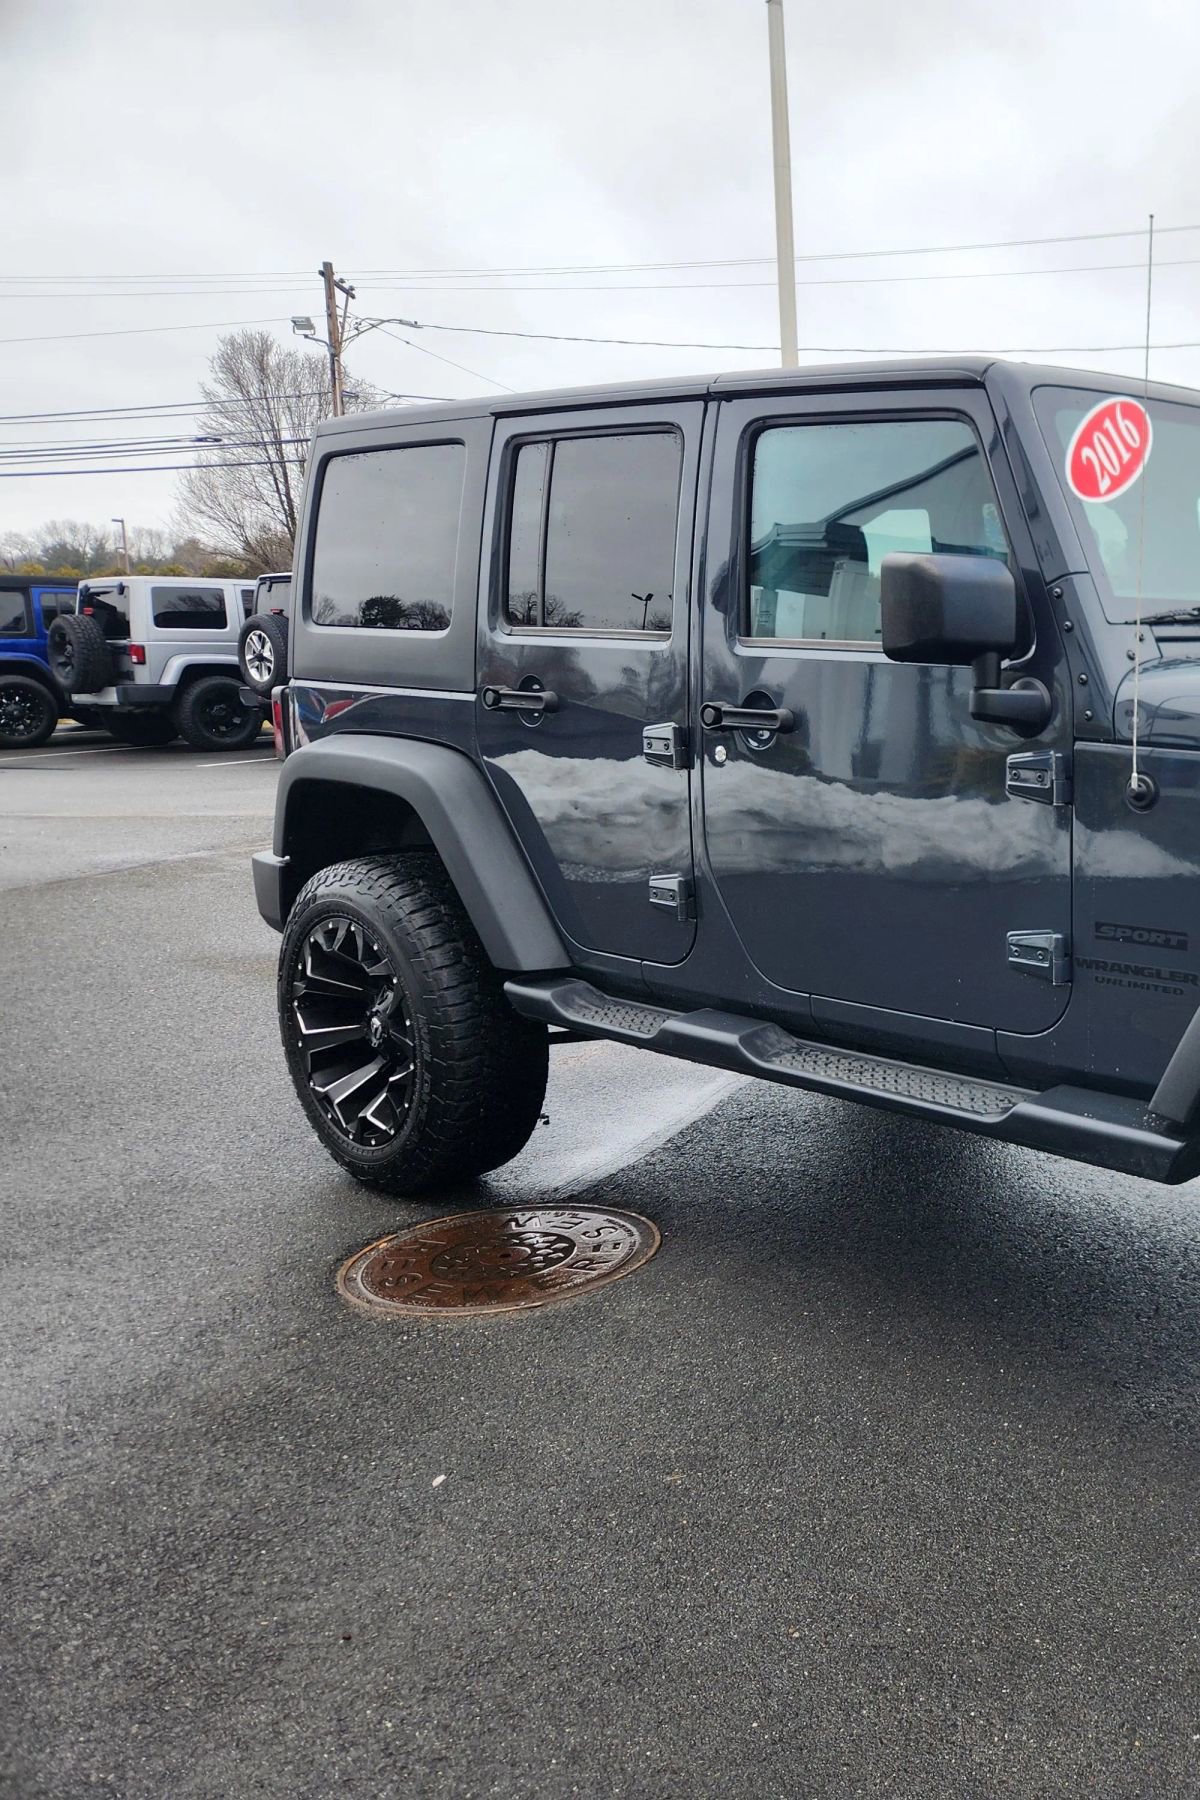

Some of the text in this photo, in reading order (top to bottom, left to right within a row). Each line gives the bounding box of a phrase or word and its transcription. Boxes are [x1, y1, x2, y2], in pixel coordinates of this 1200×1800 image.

[1081, 402, 1140, 495] 2016
[1096, 924, 1188, 947] SPORT
[1074, 957, 1199, 986] WRANGLER
[1094, 975, 1185, 996] UNLIMITED
